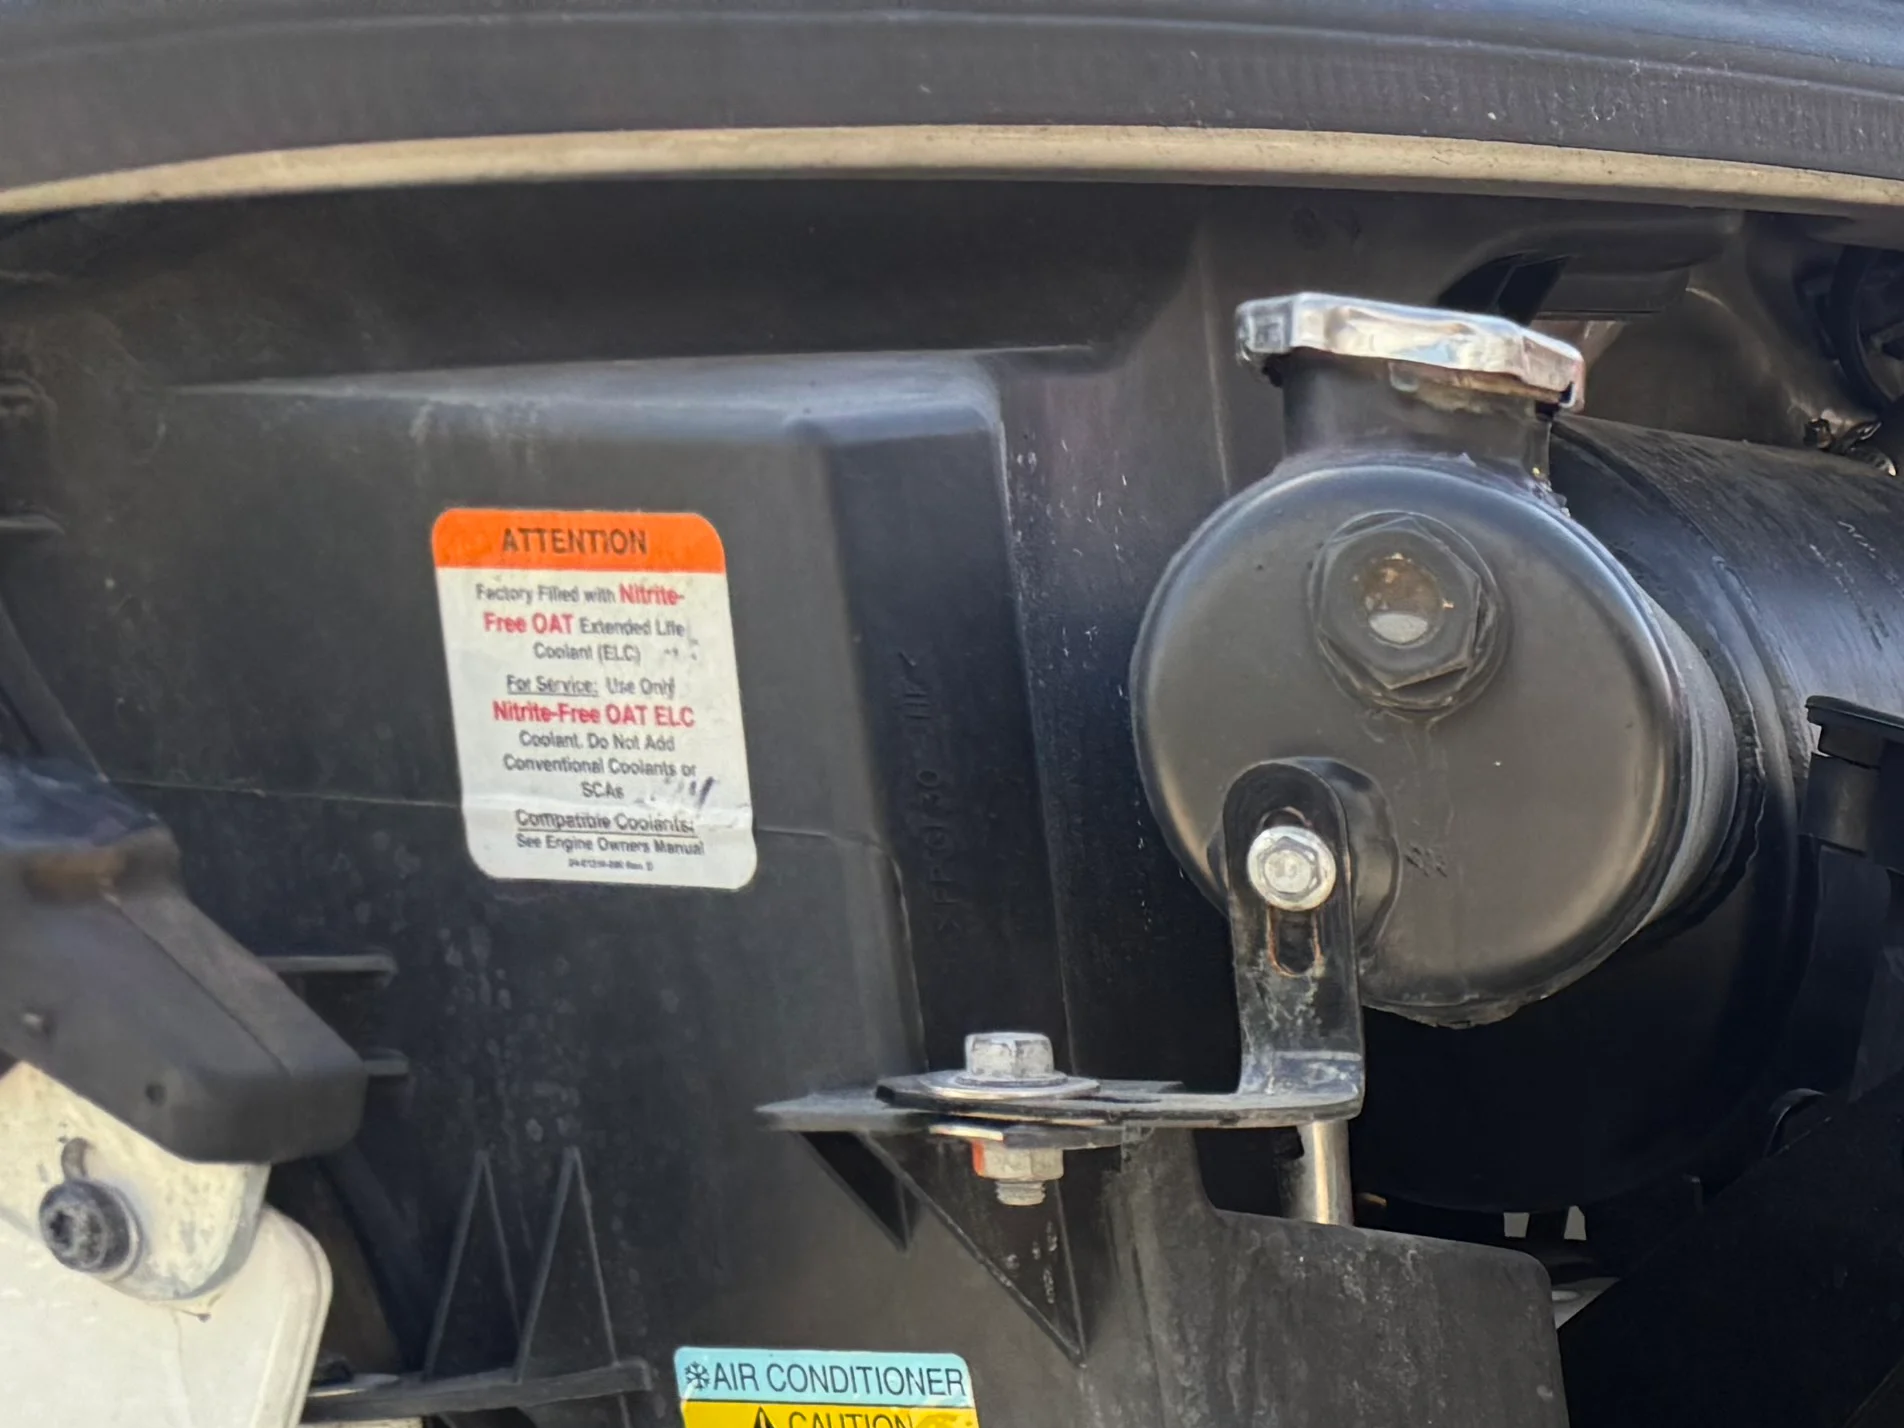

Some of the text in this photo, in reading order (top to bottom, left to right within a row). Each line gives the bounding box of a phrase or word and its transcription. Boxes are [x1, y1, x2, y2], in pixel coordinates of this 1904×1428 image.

[502, 528, 647, 554] ATTENTION
[476, 584, 684, 604] Factory Filled with Nitrite-
[484, 613, 685, 637] Free OAT Extended Life
[533, 643, 640, 663] Coolant (ELC)
[507, 675, 675, 698] For Service: Use Only
[493, 701, 695, 728] Nitrite-Free OAT ELC
[519, 732, 675, 751] Coolant. Do Not Add
[504, 754, 696, 777] Conventional Coolants or
[581, 782, 624, 798] SCAs
[516, 810, 695, 833] Compatible Coolants:
[517, 834, 704, 855] See Engine Owners Manual
[713, 1363, 967, 1397] AIR CONDITIONER
